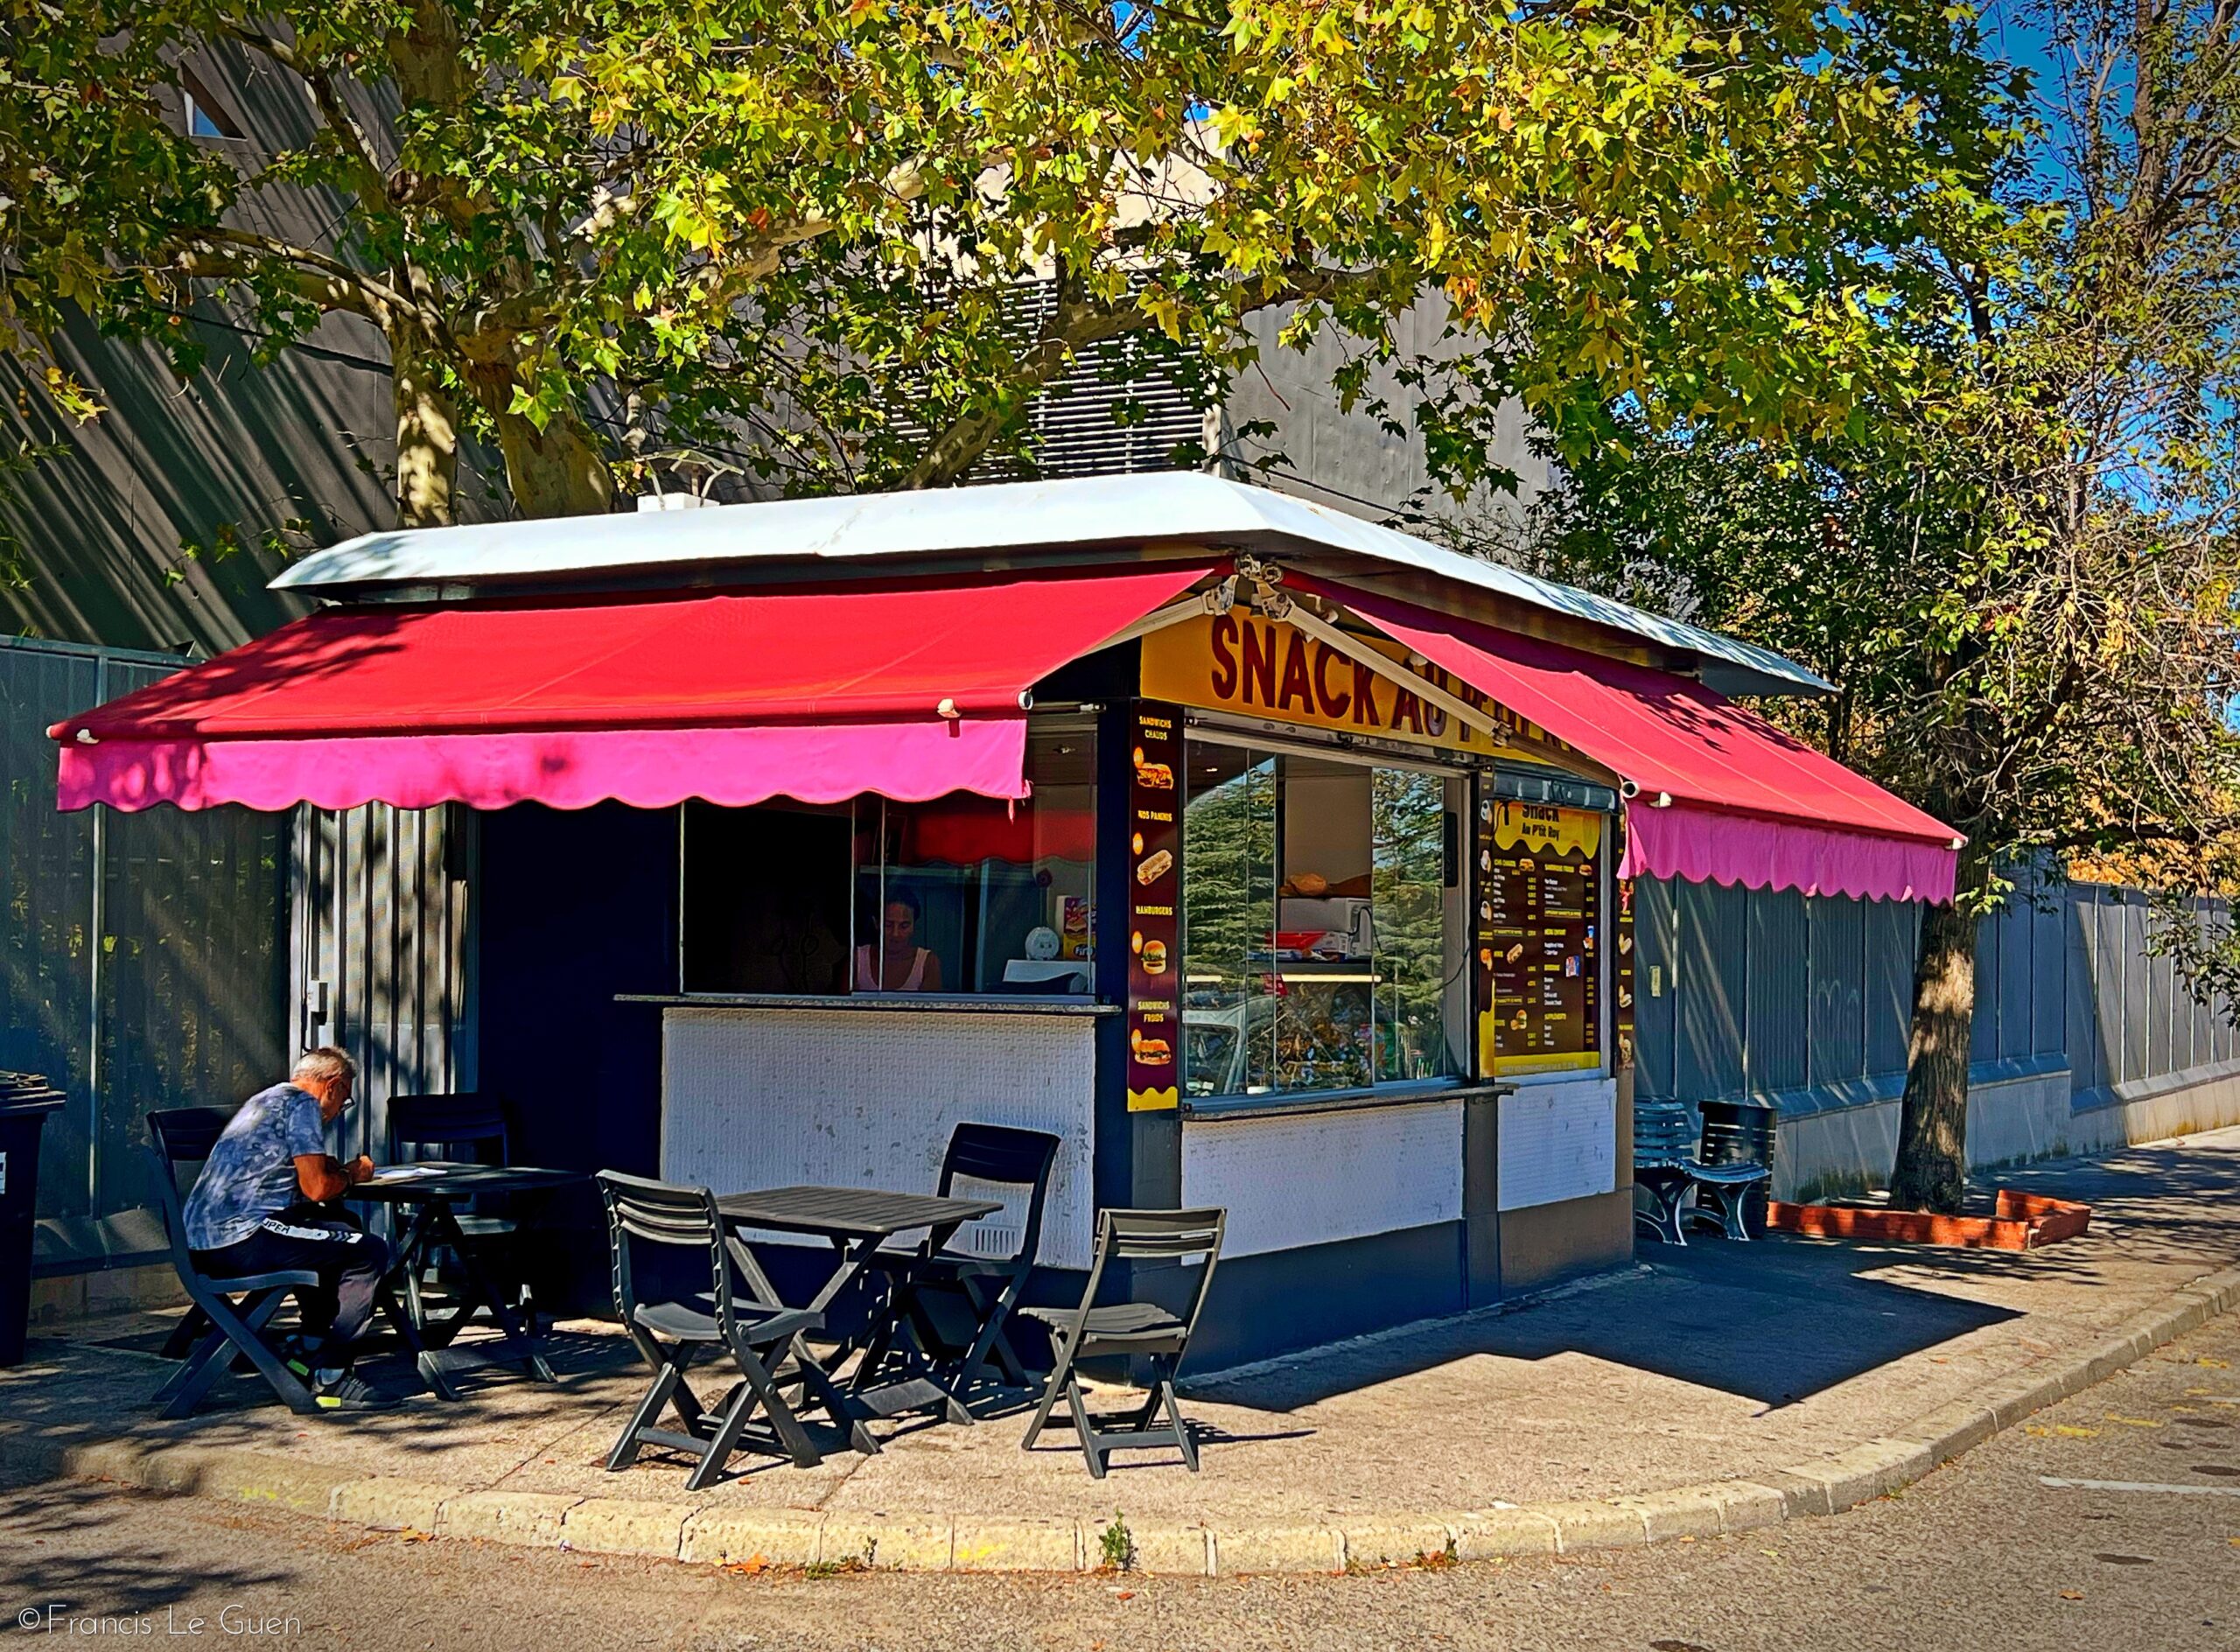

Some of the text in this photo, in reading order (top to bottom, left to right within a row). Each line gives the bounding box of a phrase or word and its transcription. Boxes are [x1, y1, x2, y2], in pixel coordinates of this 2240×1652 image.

[1211, 614, 1380, 726] SNACK
[1391, 657, 1447, 737] AU
[1522, 805, 1560, 822] Snack
[1522, 822, 1530, 834] Au
[1135, 905, 1173, 916] HAMBURGERS
